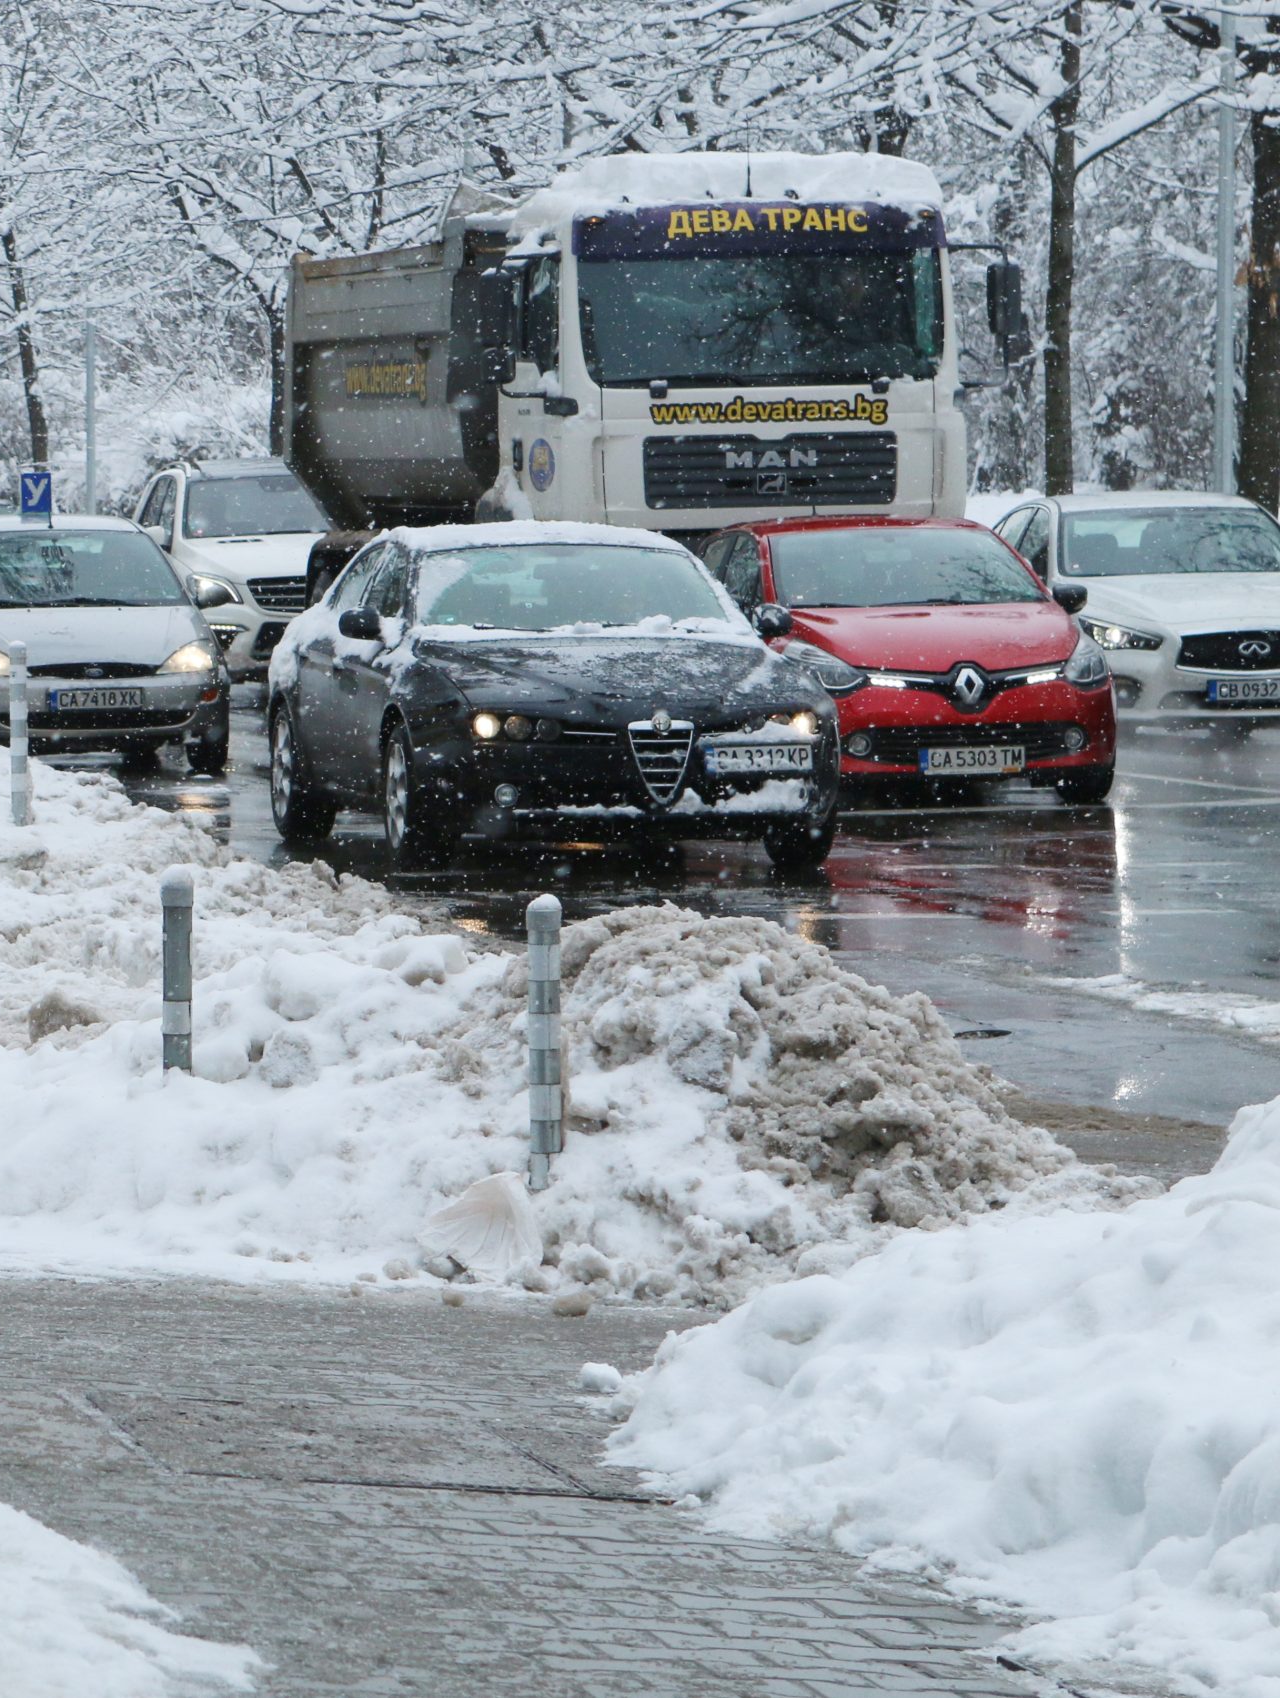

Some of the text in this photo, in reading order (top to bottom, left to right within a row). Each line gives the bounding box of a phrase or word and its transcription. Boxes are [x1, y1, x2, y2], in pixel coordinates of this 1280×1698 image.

[667, 208, 868, 239] ДЕВА ТРАНС
[650, 394, 888, 425] www.devatrans.bg
[725, 450, 817, 469] MAN
[59, 692, 79, 707] CA
[1219, 682, 1278, 698] CB 0932
[930, 748, 1023, 768] CA 5303 TM
